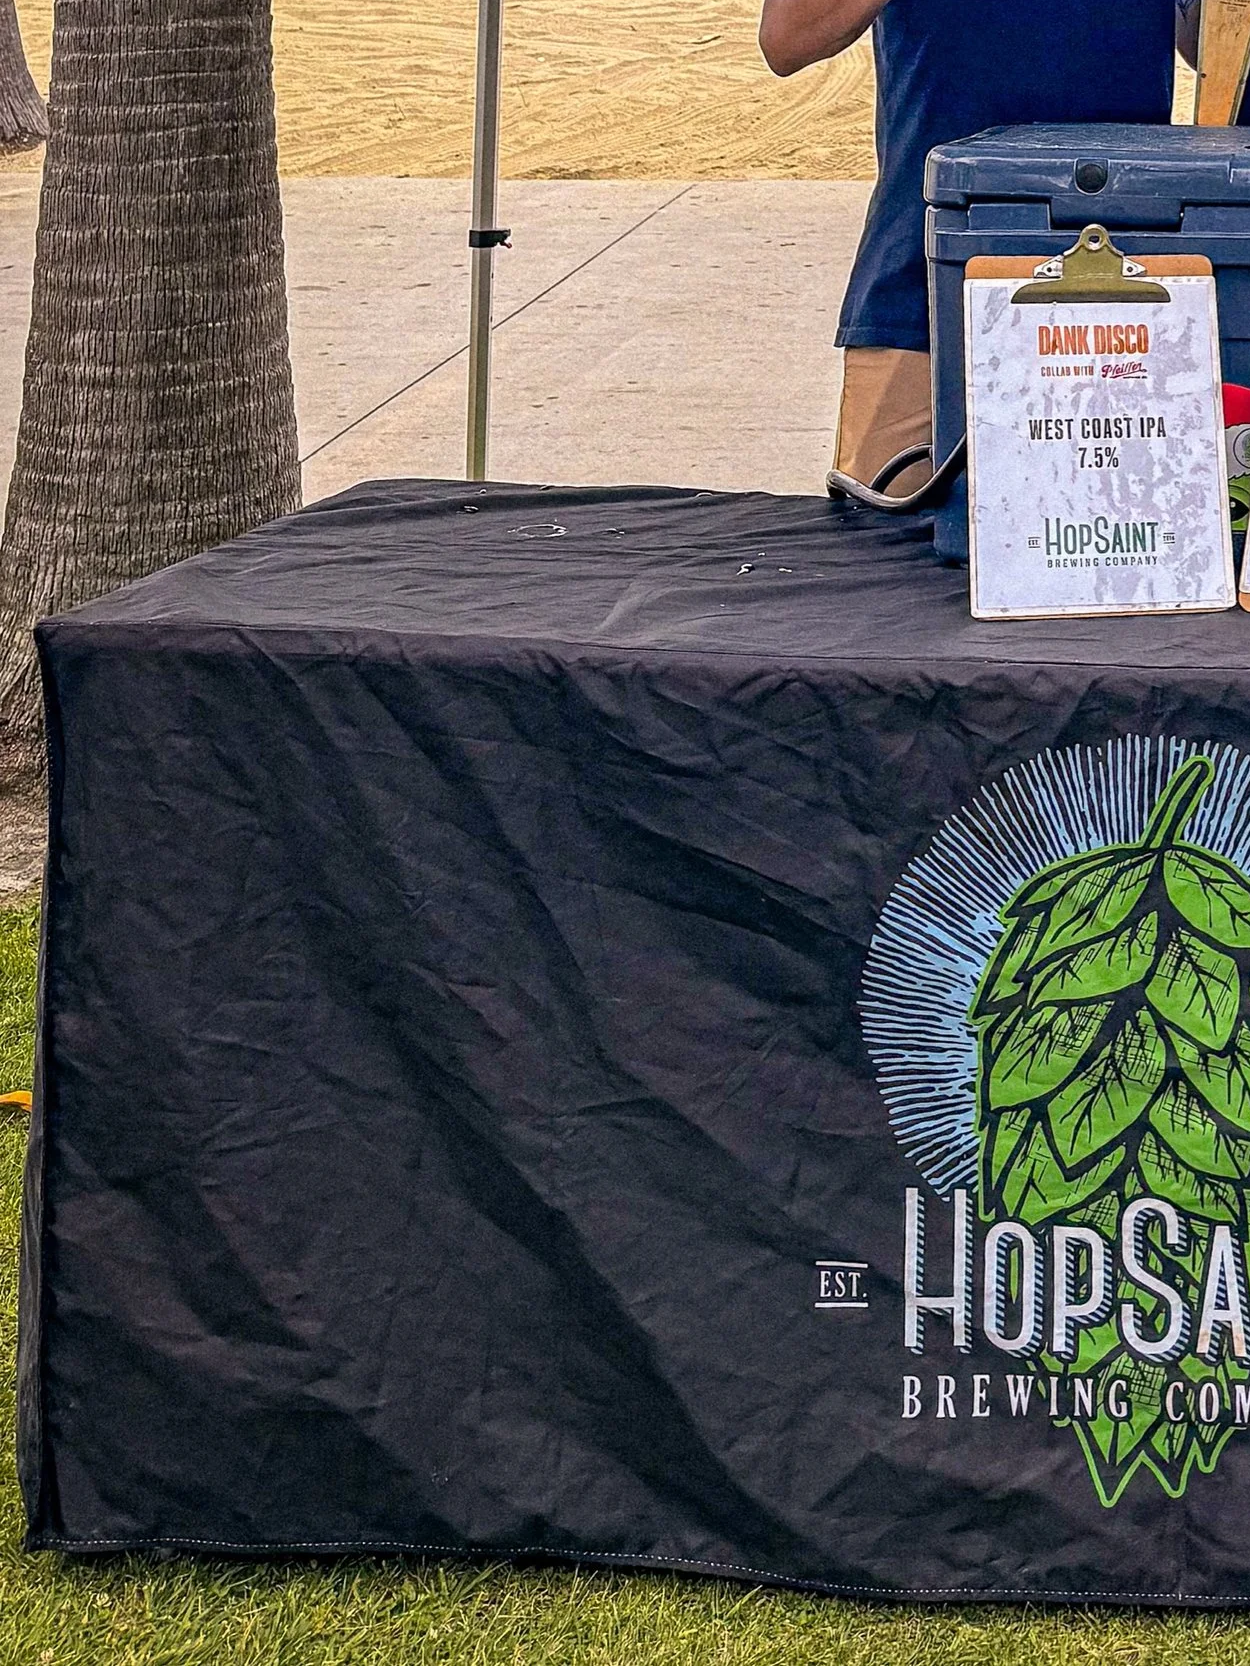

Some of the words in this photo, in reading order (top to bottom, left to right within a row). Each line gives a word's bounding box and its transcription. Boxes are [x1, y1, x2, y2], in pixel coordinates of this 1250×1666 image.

[1038, 325, 1090, 355] DANK
[1093, 324, 1149, 355] DISCO
[1041, 366, 1071, 377] COLLAB
[1073, 365, 1094, 376] WITH
[1028, 418, 1073, 440] WEST
[1081, 417, 1133, 439] COAST
[1139, 416, 1167, 438] IPA
[1078, 446, 1119, 469] 7.5%
[1047, 557, 1100, 569] BREWING
[1105, 555, 1158, 567] COMPANY
[819, 1271, 868, 1299] EST.
[902, 1373, 1128, 1420] BREWING
